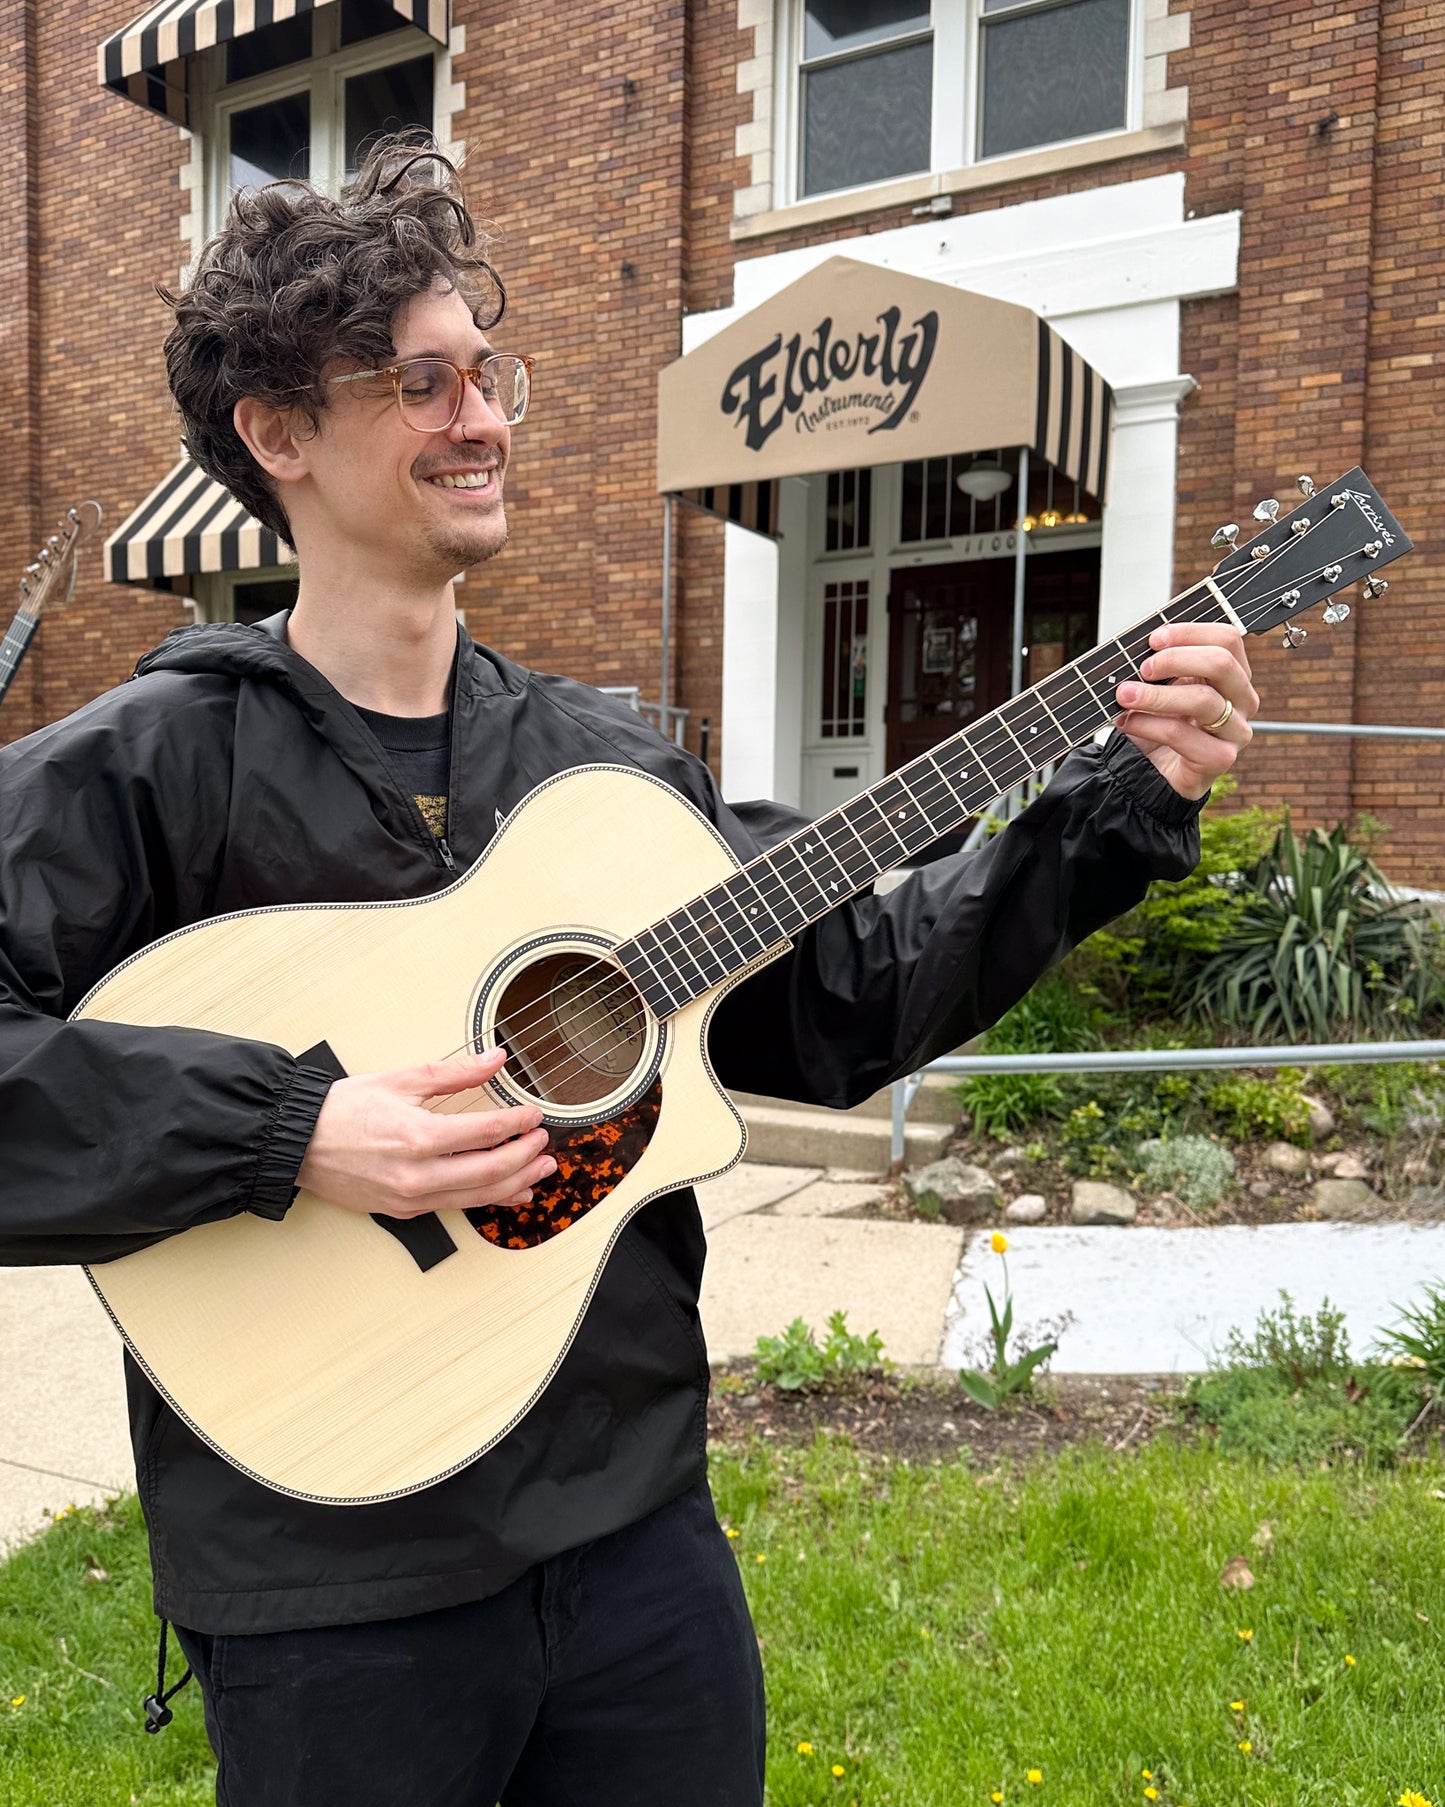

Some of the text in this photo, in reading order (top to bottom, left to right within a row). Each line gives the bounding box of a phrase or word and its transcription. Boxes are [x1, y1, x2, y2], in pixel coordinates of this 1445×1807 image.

[721, 305, 939, 452] Elderly
[795, 391, 895, 434] Instruments
[964, 535, 1017, 555] 1100
